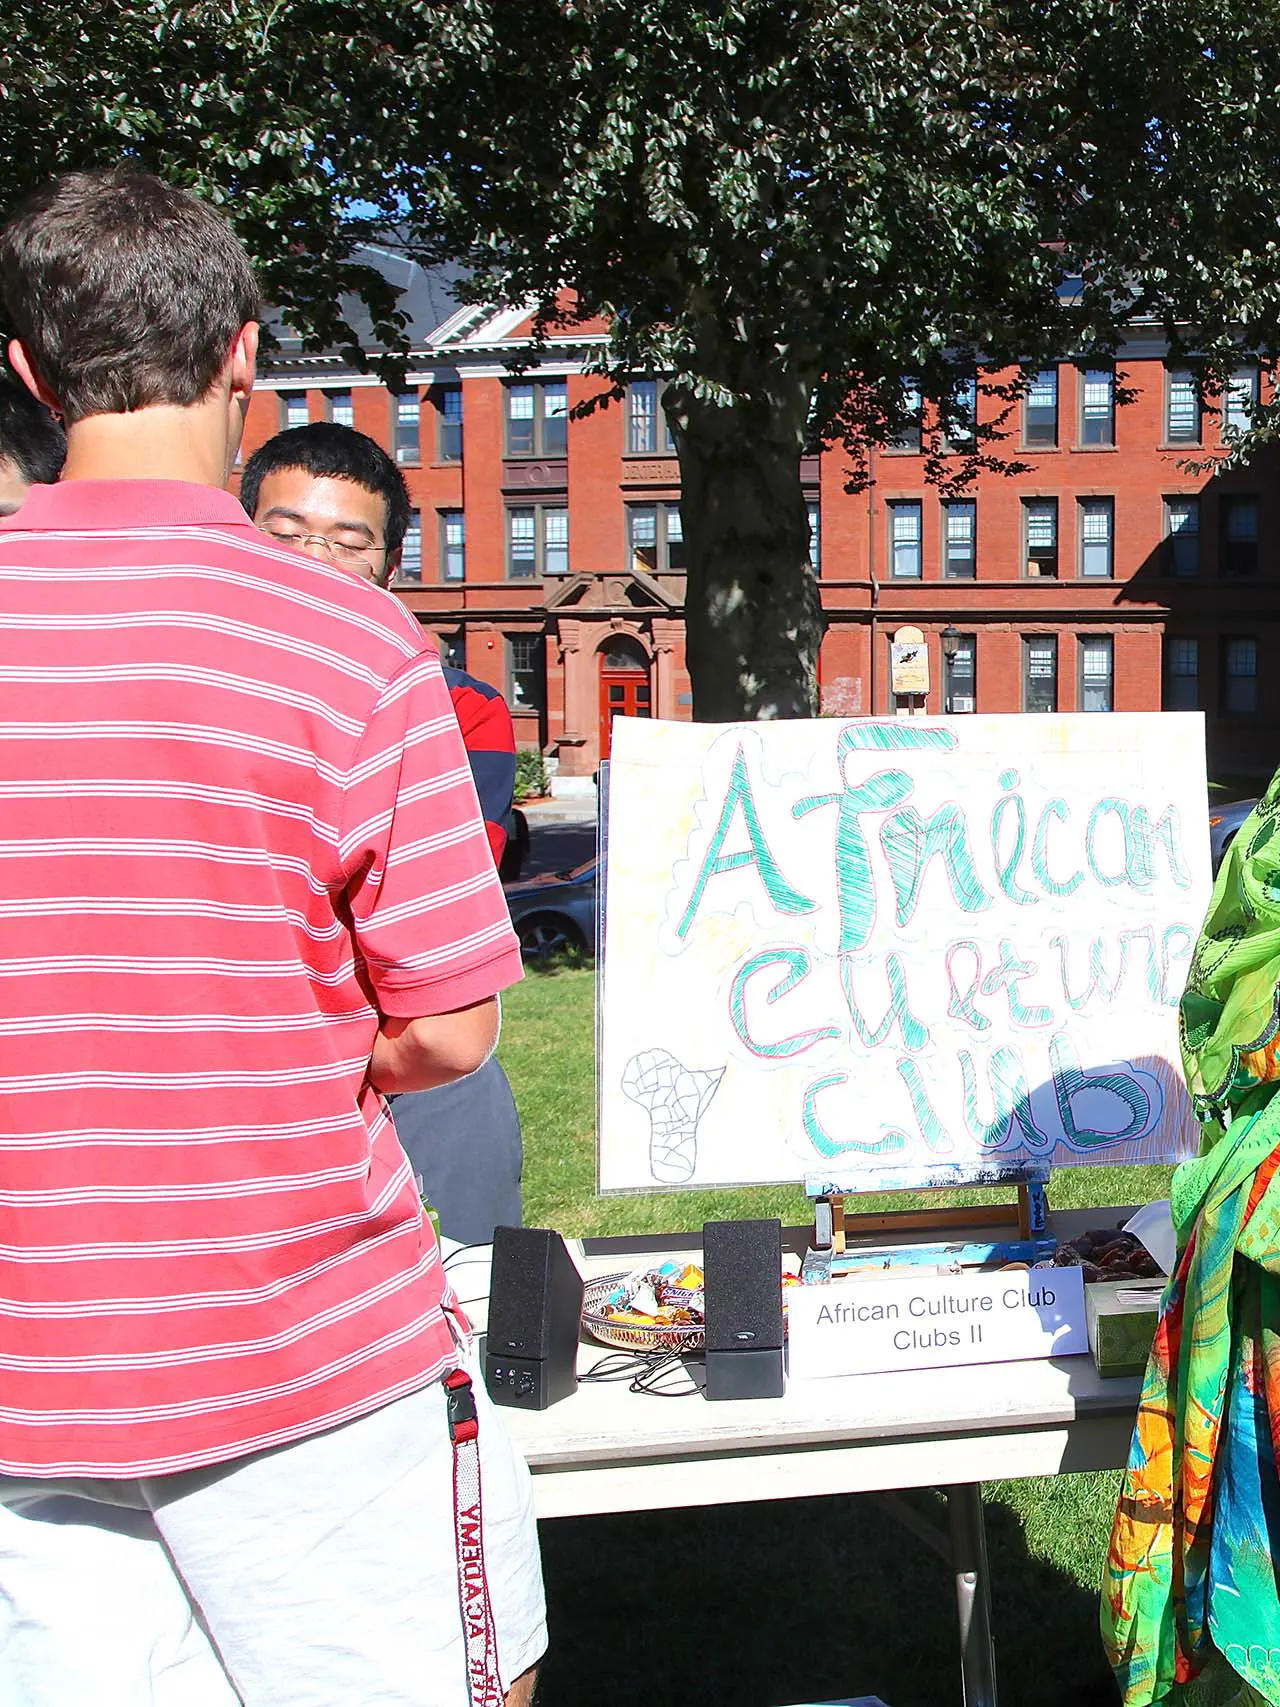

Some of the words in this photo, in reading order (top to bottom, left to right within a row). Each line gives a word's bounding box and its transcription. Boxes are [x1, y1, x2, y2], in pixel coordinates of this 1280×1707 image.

[662, 1287, 695, 1297] SNICK
[816, 1302, 899, 1325] African
[908, 1295, 993, 1317] Culture
[1002, 1288, 1056, 1309] Club
[893, 1330, 961, 1350] Clubs
